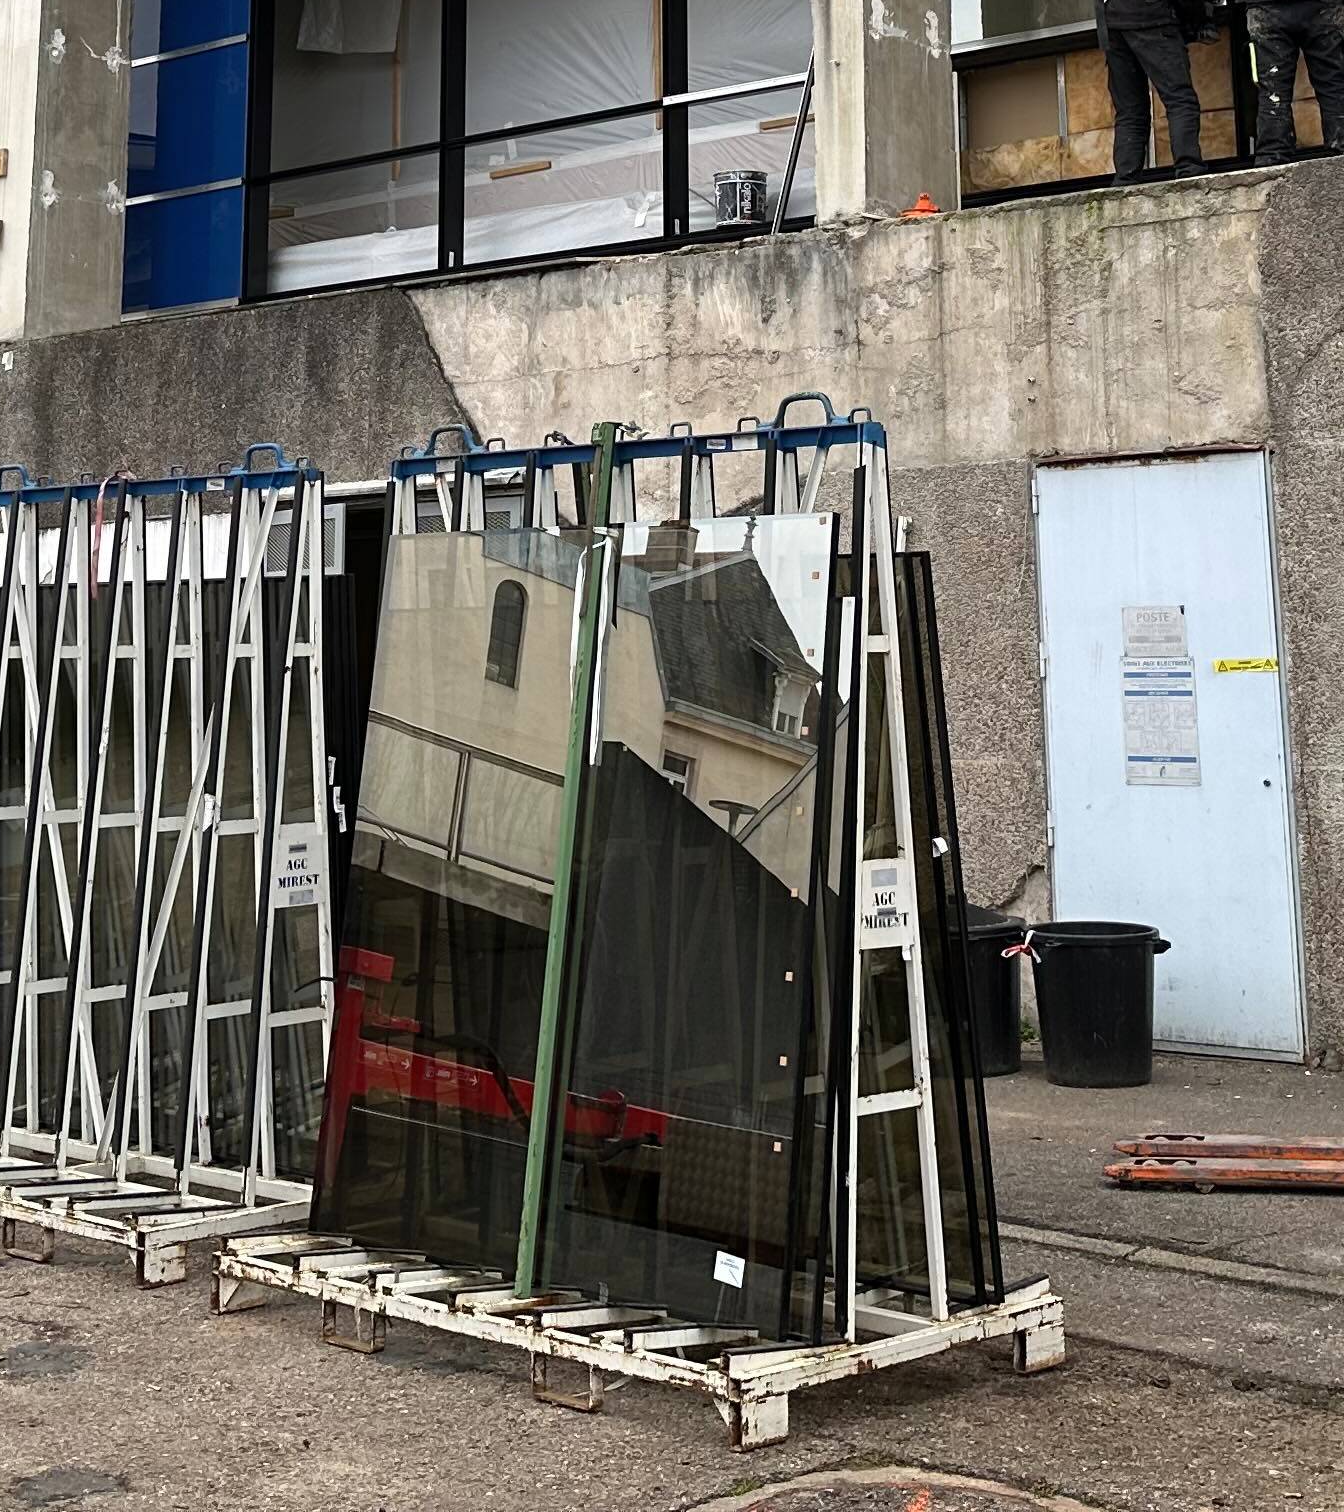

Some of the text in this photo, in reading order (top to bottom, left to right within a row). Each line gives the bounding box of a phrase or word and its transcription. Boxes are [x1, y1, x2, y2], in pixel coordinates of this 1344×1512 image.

[1136, 612, 1169, 623] POSTE
[286, 857, 308, 871] AGC
[277, 874, 320, 889] MIREST
[871, 891, 896, 907] AGC
